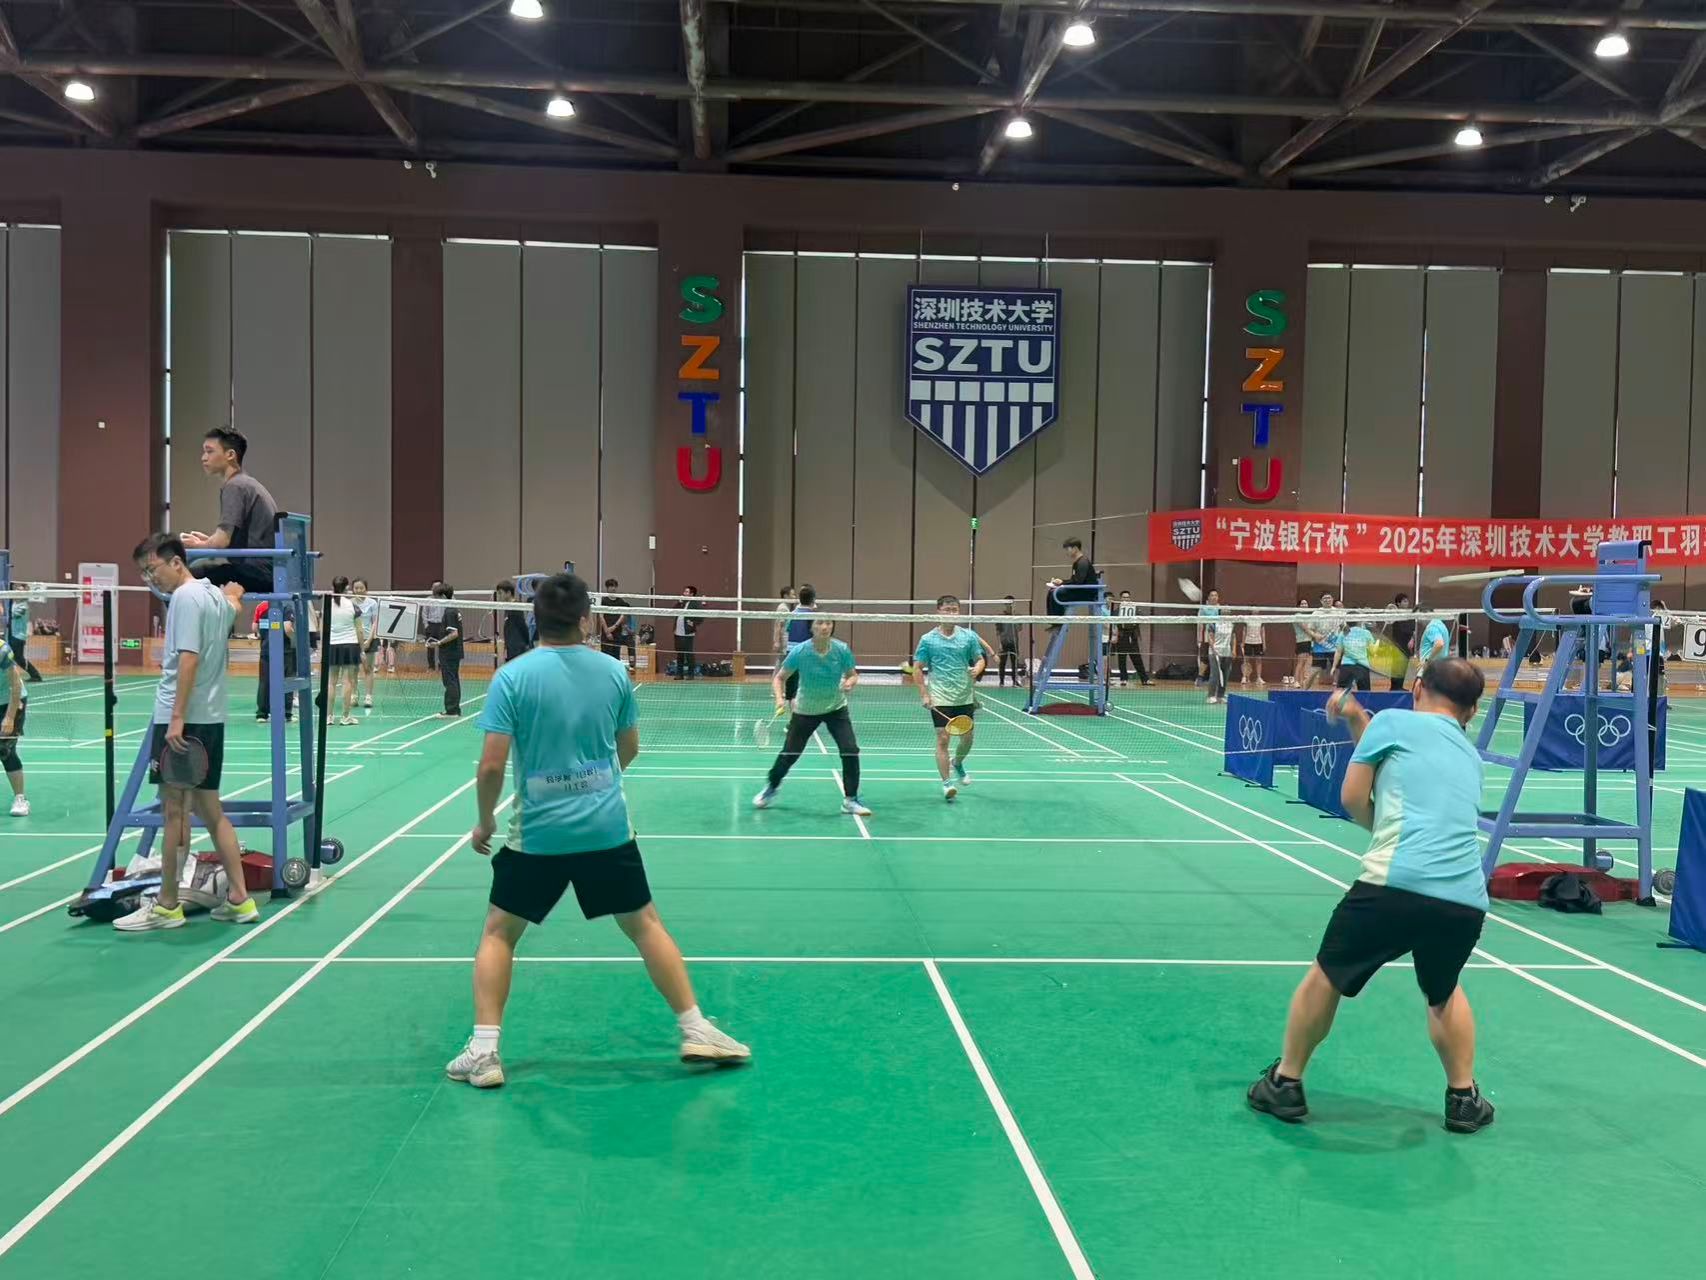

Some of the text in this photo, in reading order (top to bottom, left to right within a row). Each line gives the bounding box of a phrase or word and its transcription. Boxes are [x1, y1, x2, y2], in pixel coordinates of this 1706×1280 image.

[914, 297, 1054, 323] 深圳技术大学
[956, 323, 1007, 331] TECHNOLOGY
[913, 337, 1052, 374] SZTU
[678, 274, 724, 491] SZTU
[1238, 290, 1287, 502] SZTU
[1173, 527, 1200, 535] SZTU
[387, 604, 406, 633] 7
[1694, 628, 1706, 657] 9
